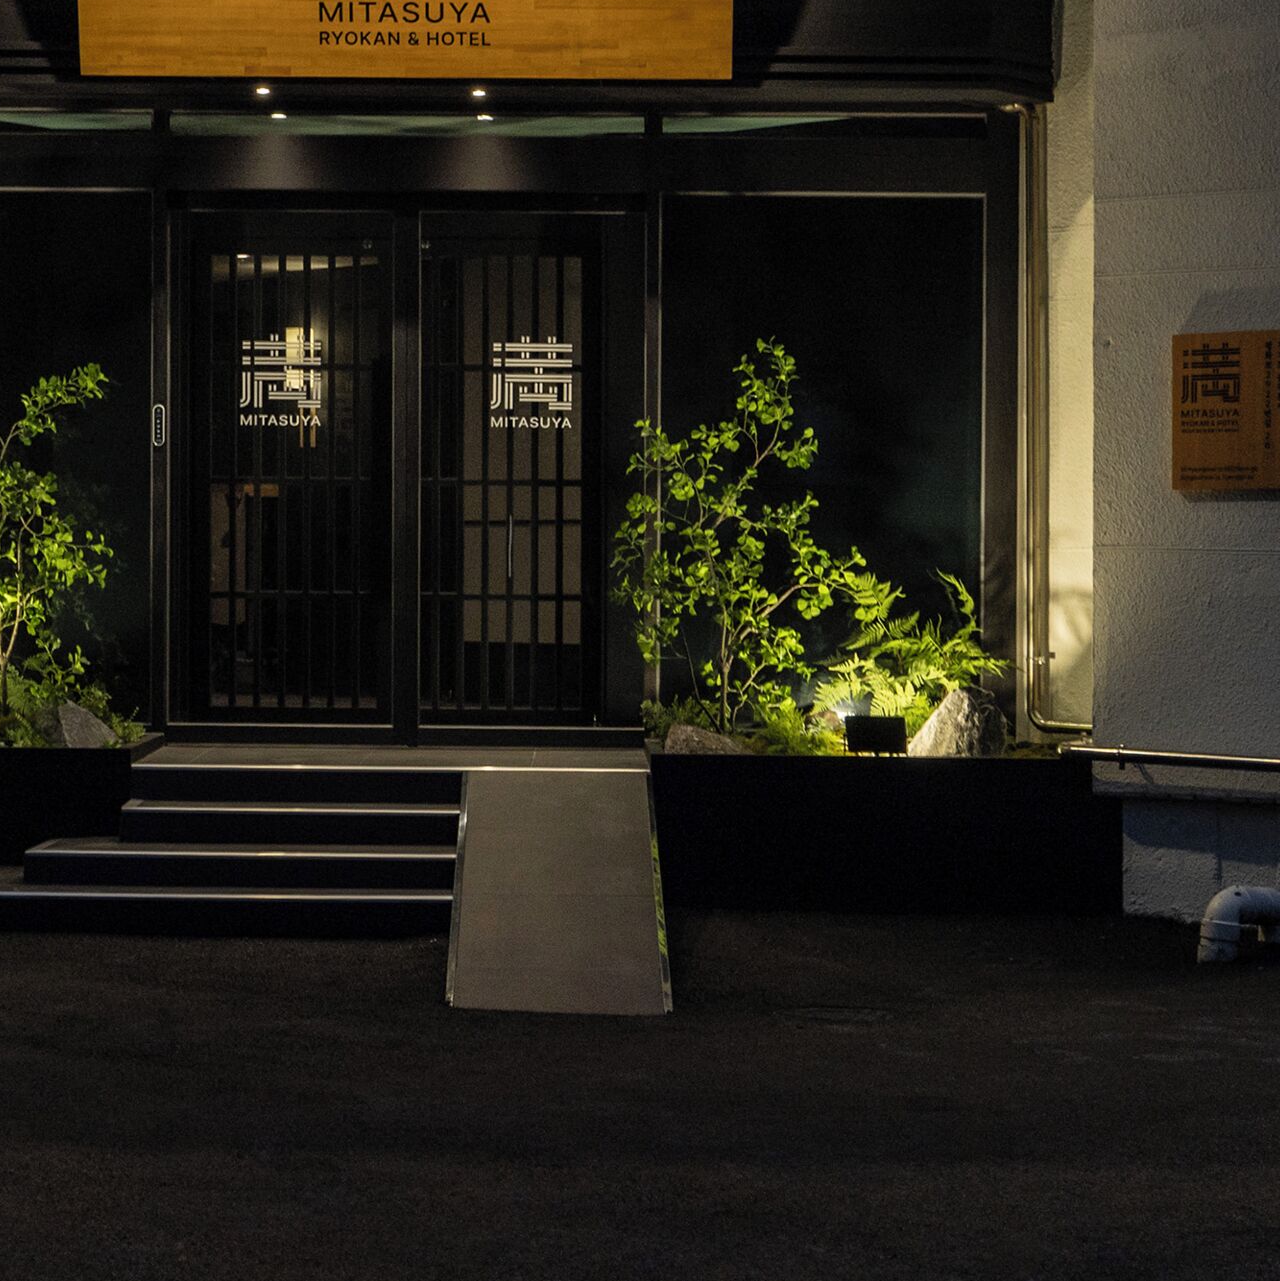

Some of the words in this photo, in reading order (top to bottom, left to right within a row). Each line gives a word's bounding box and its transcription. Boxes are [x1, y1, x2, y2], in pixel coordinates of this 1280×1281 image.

[318, 1, 491, 24] MITASUYA
[319, 30, 400, 46] RYOKAN
[407, 31, 420, 46] &
[426, 31, 491, 47] HOTEL
[1180, 408, 1240, 419] MITASUYA
[240, 414, 321, 427] MITASUYA
[490, 416, 572, 429] MITASUYA
